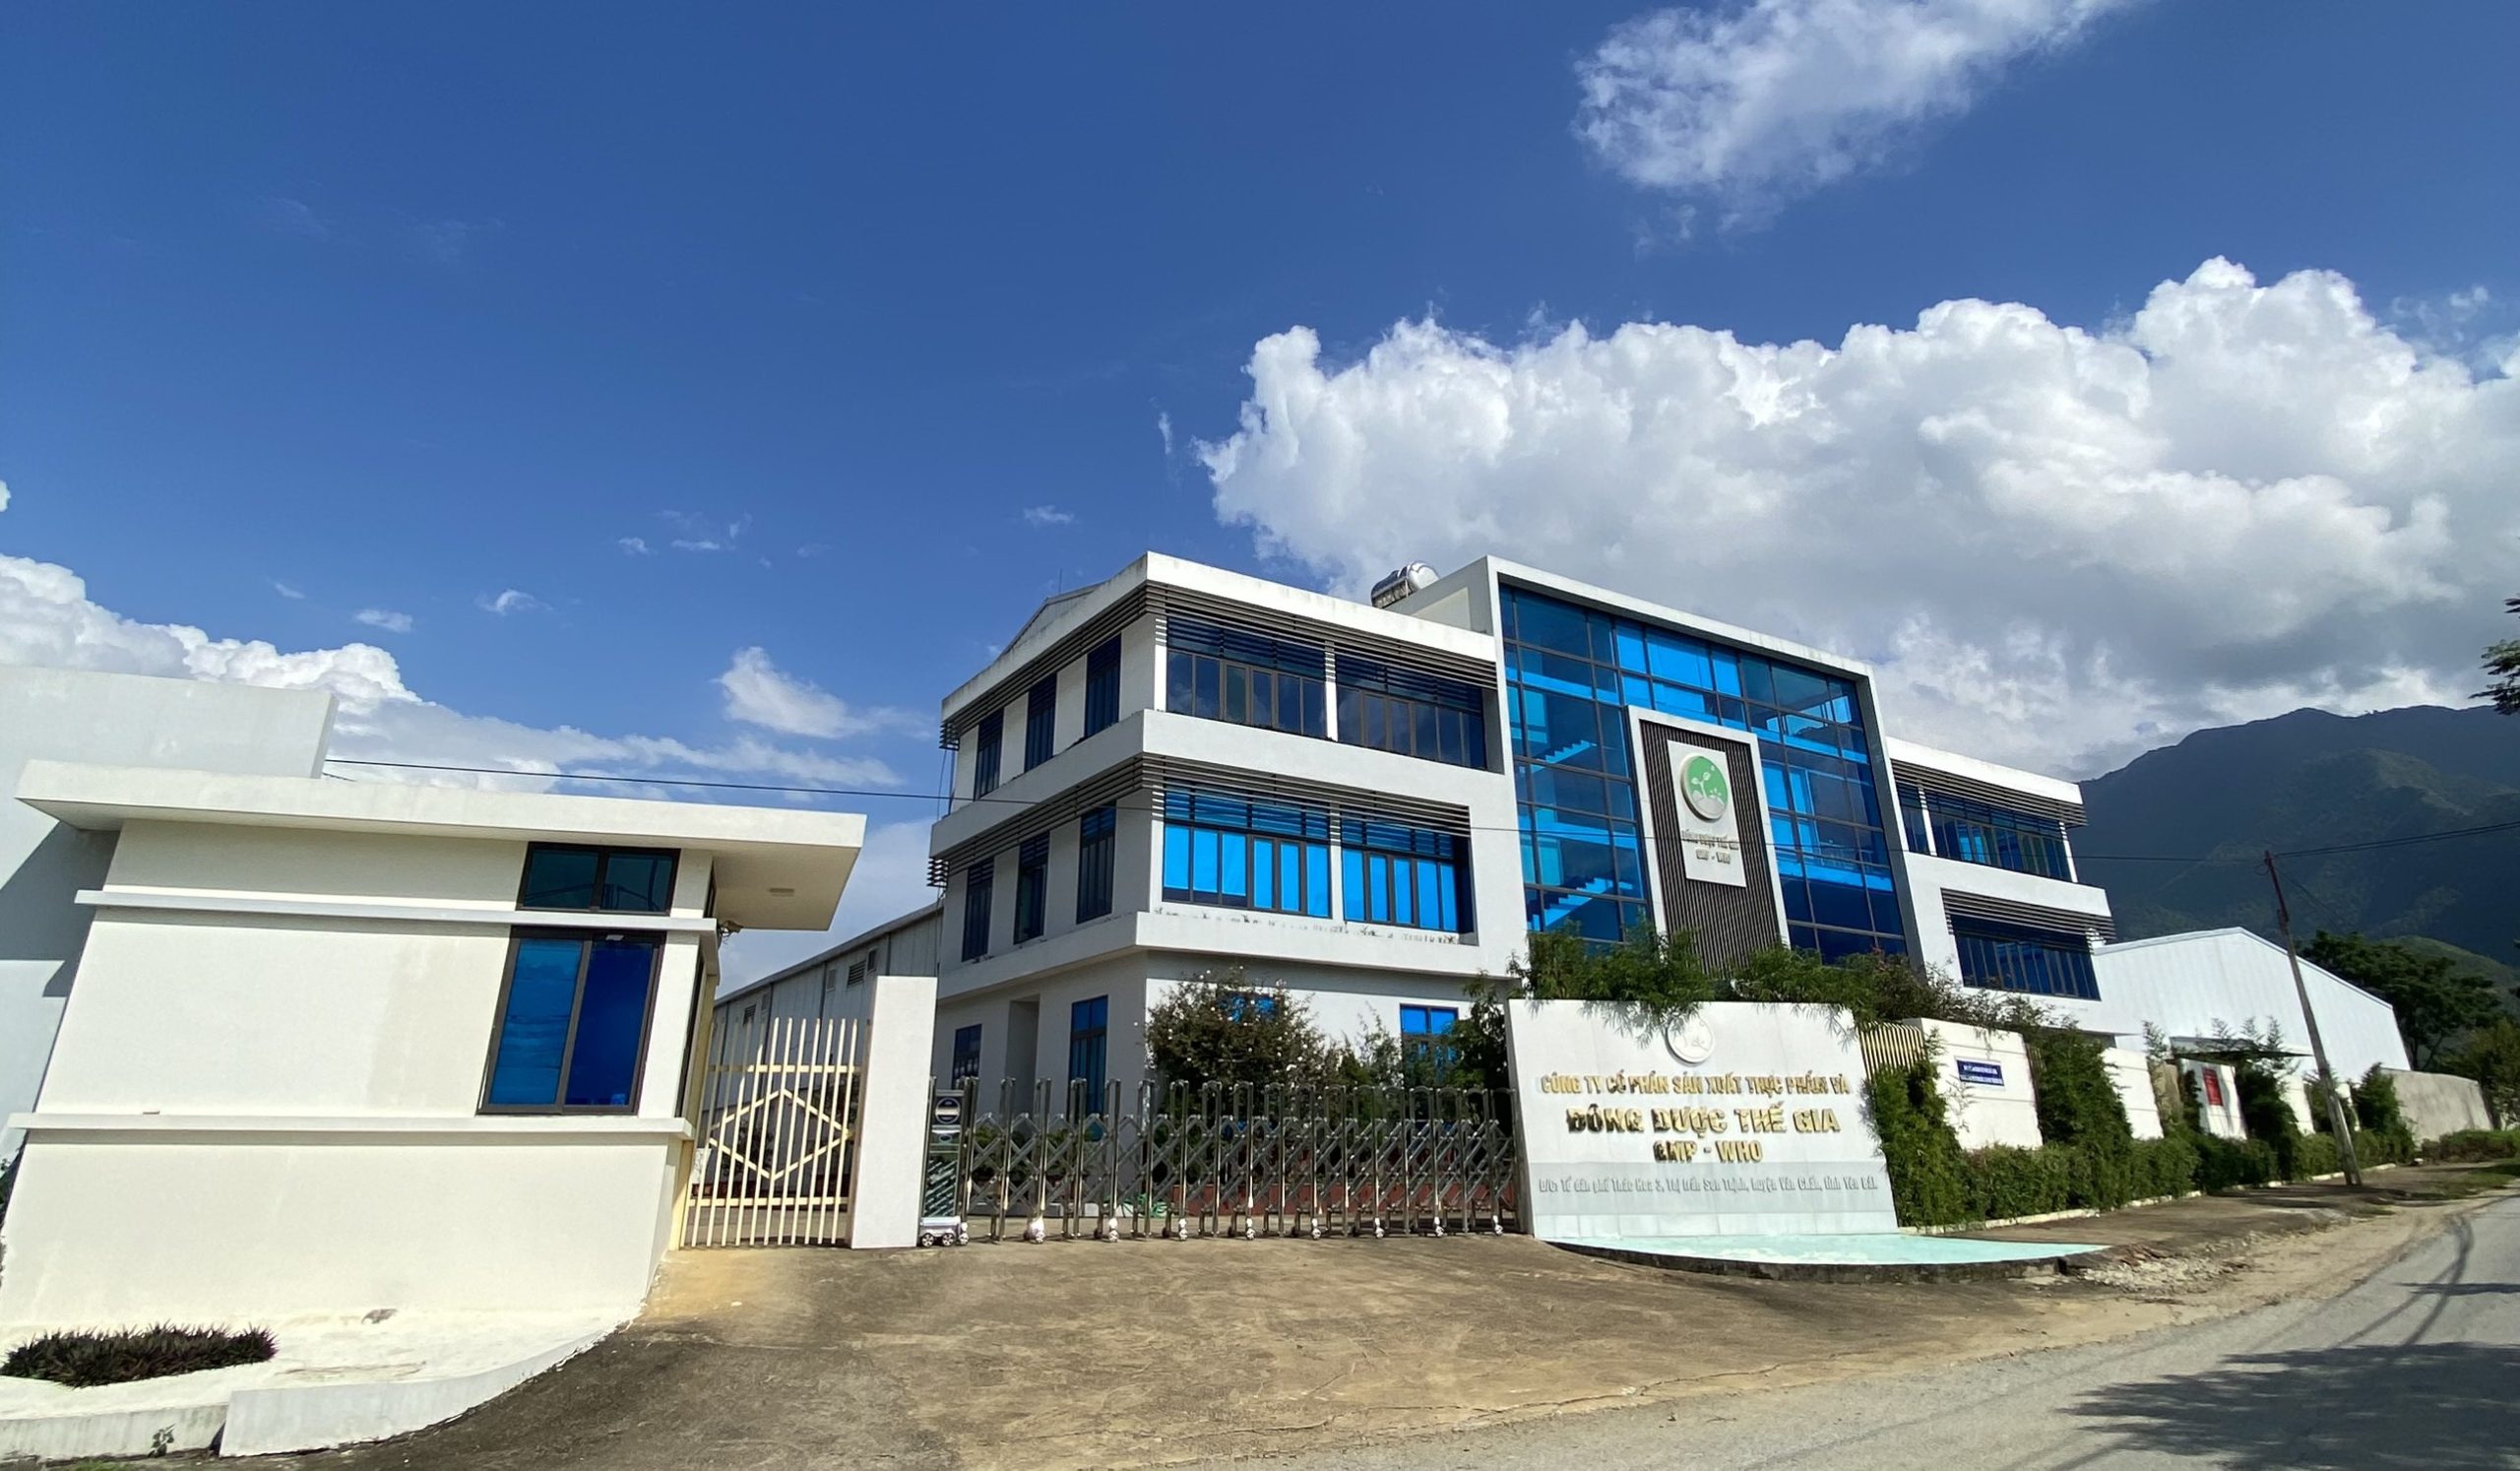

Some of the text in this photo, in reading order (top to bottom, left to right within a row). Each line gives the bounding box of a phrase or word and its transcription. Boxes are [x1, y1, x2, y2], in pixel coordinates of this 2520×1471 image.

[1584, 1075, 1602, 1094] TY
[1793, 1108, 1841, 1133] GIA
[1715, 1140, 1763, 1164] WHO
